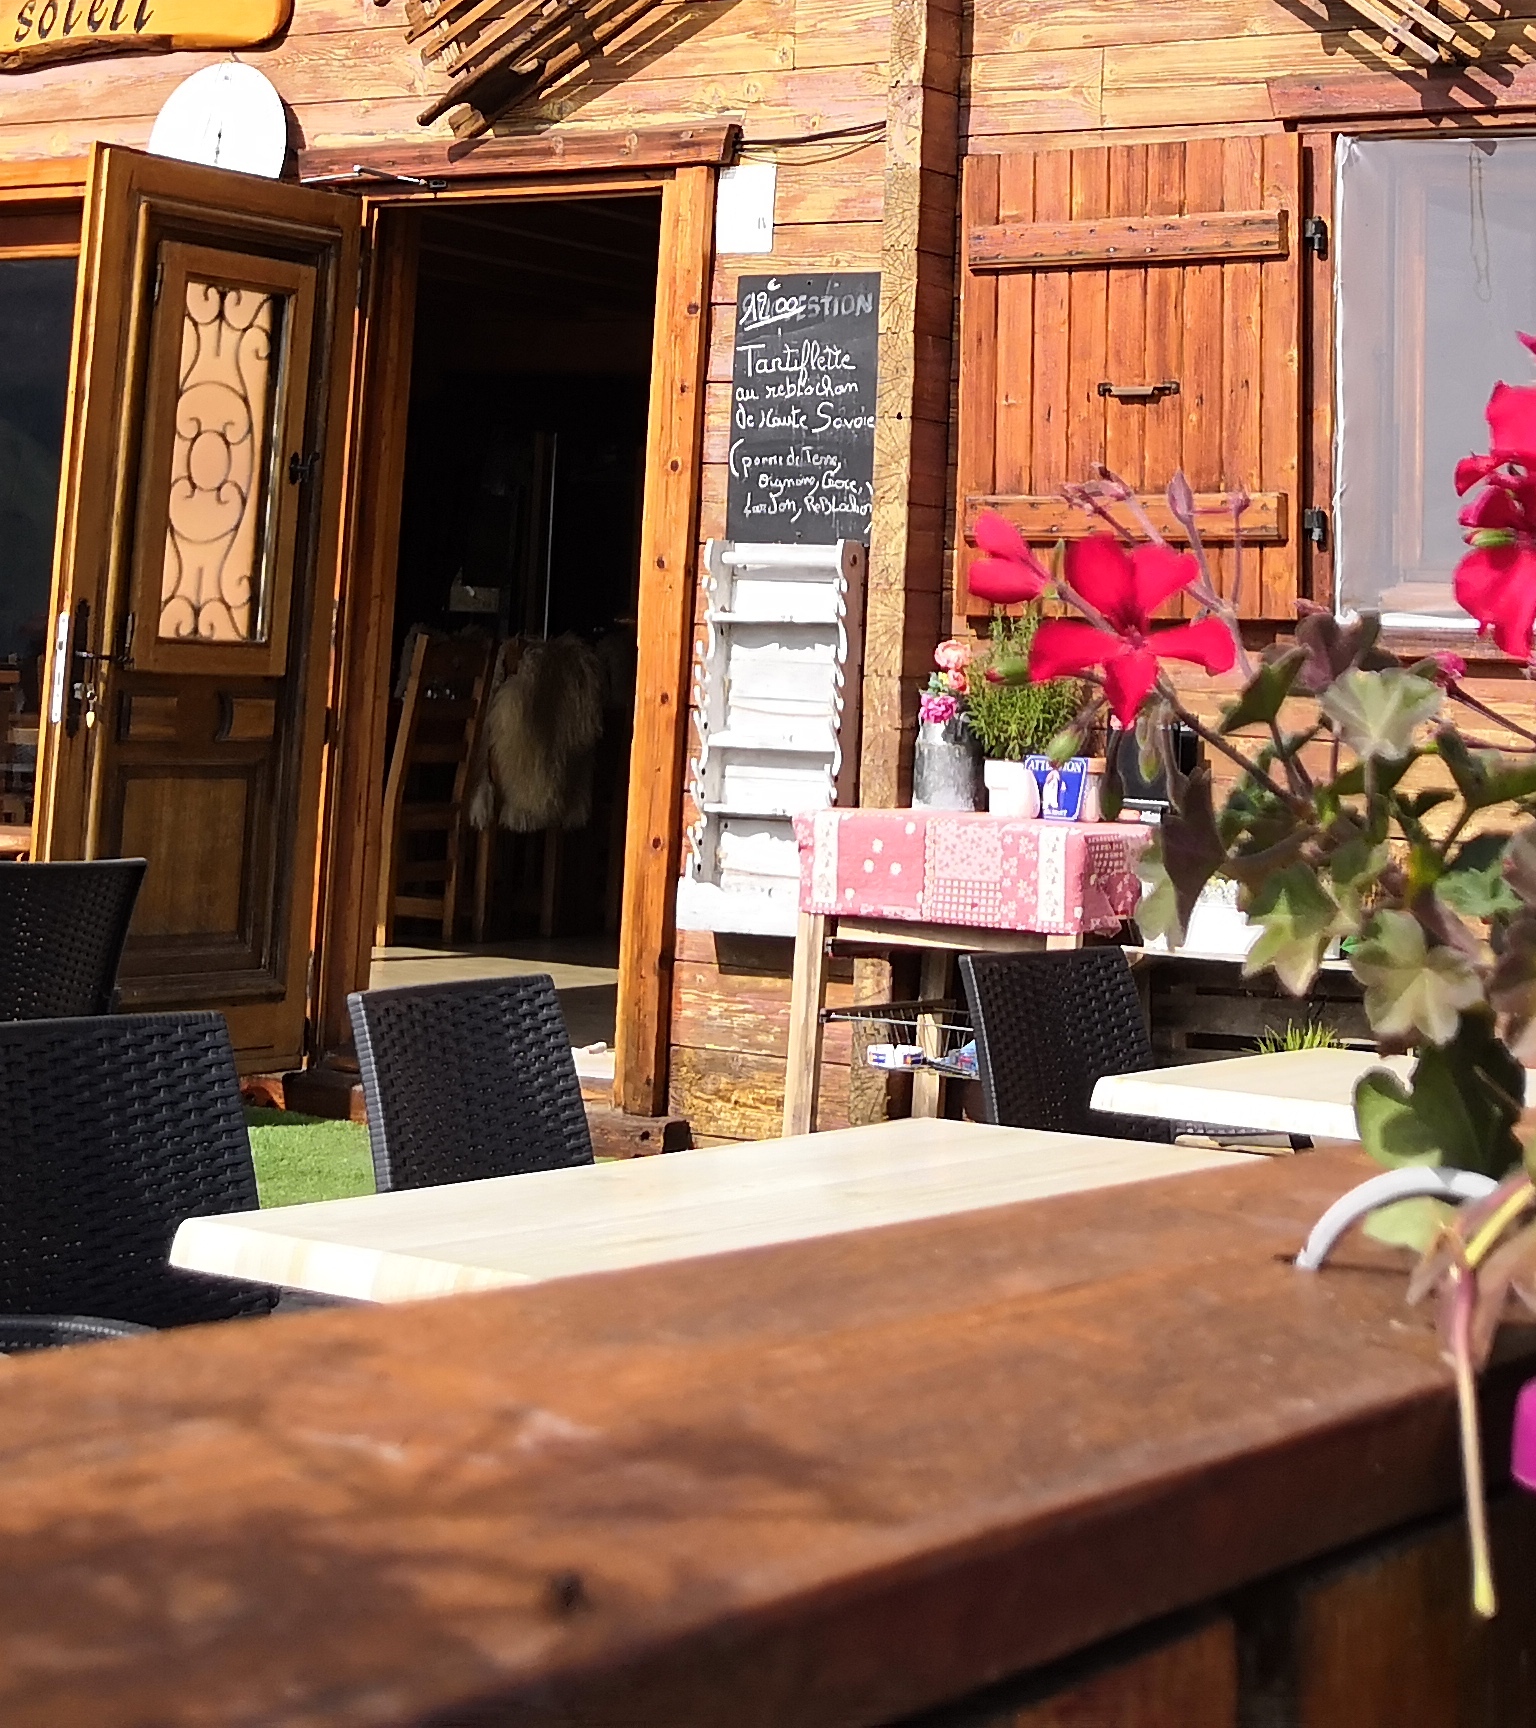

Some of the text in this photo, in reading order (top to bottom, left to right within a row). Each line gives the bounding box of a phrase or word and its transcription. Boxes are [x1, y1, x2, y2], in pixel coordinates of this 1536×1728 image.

[736, 338, 857, 387] Tartiflette
[736, 386, 760, 402] au
[811, 401, 876, 433] Savoie
